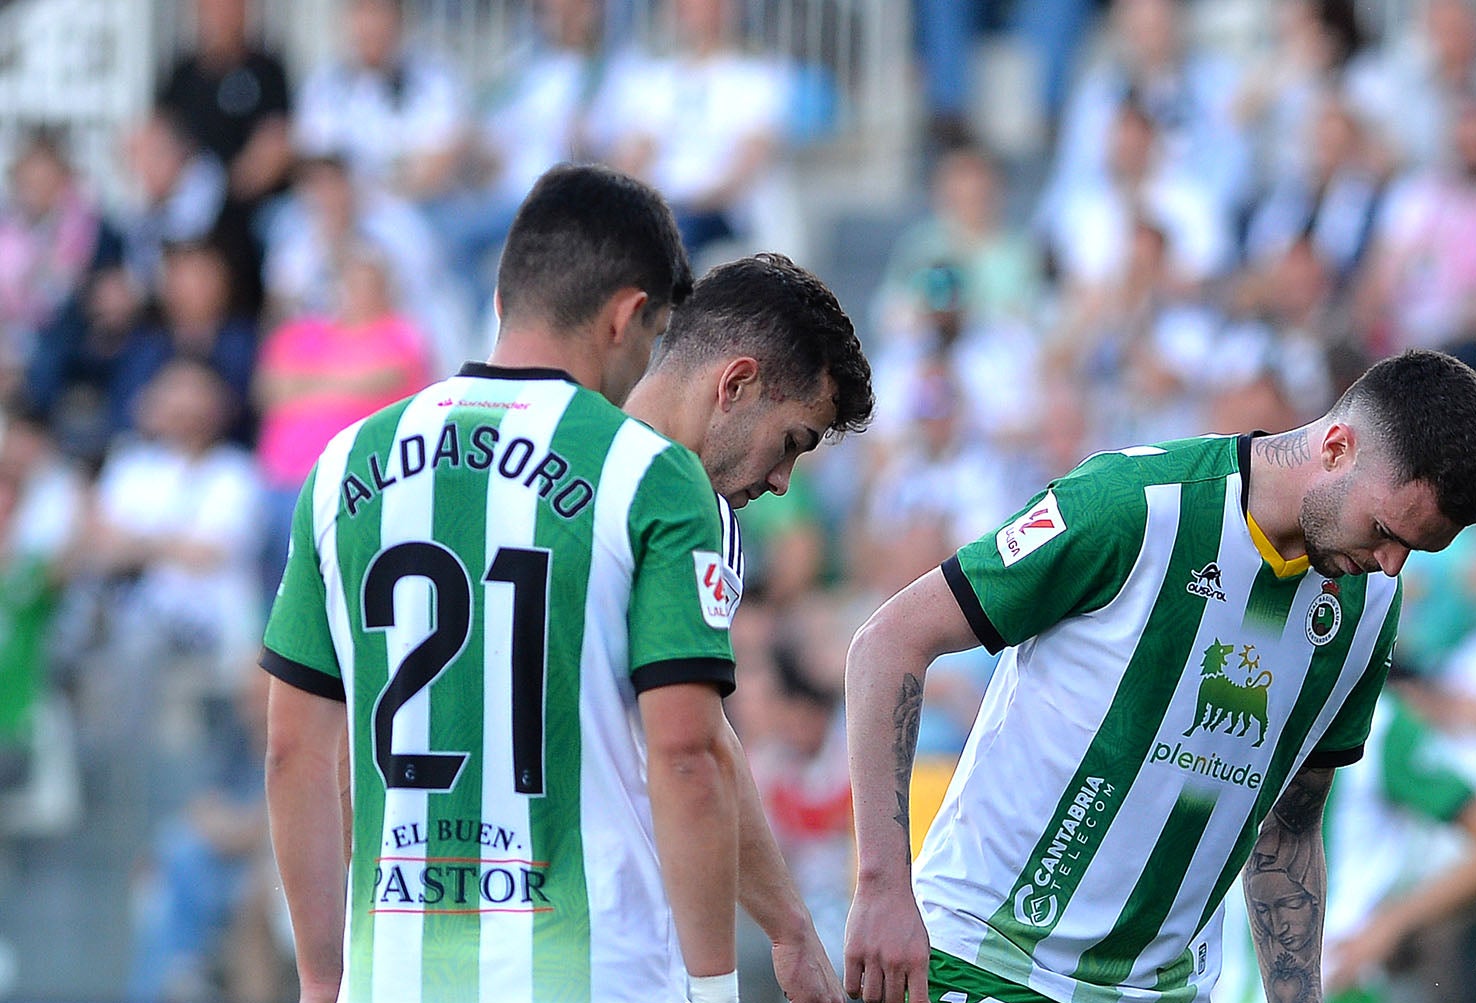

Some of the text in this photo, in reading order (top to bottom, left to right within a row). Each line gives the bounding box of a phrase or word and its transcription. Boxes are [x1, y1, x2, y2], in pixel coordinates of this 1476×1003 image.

[341, 422, 595, 521] ALDASORO
[363, 541, 554, 798] 21
[1149, 742, 1262, 790] plenitude
[391, 818, 516, 852] EL BUEN
[1033, 775, 1105, 888] CANTABRIA
[1049, 782, 1116, 891] TELECOM
[368, 863, 551, 905] PASTOR
